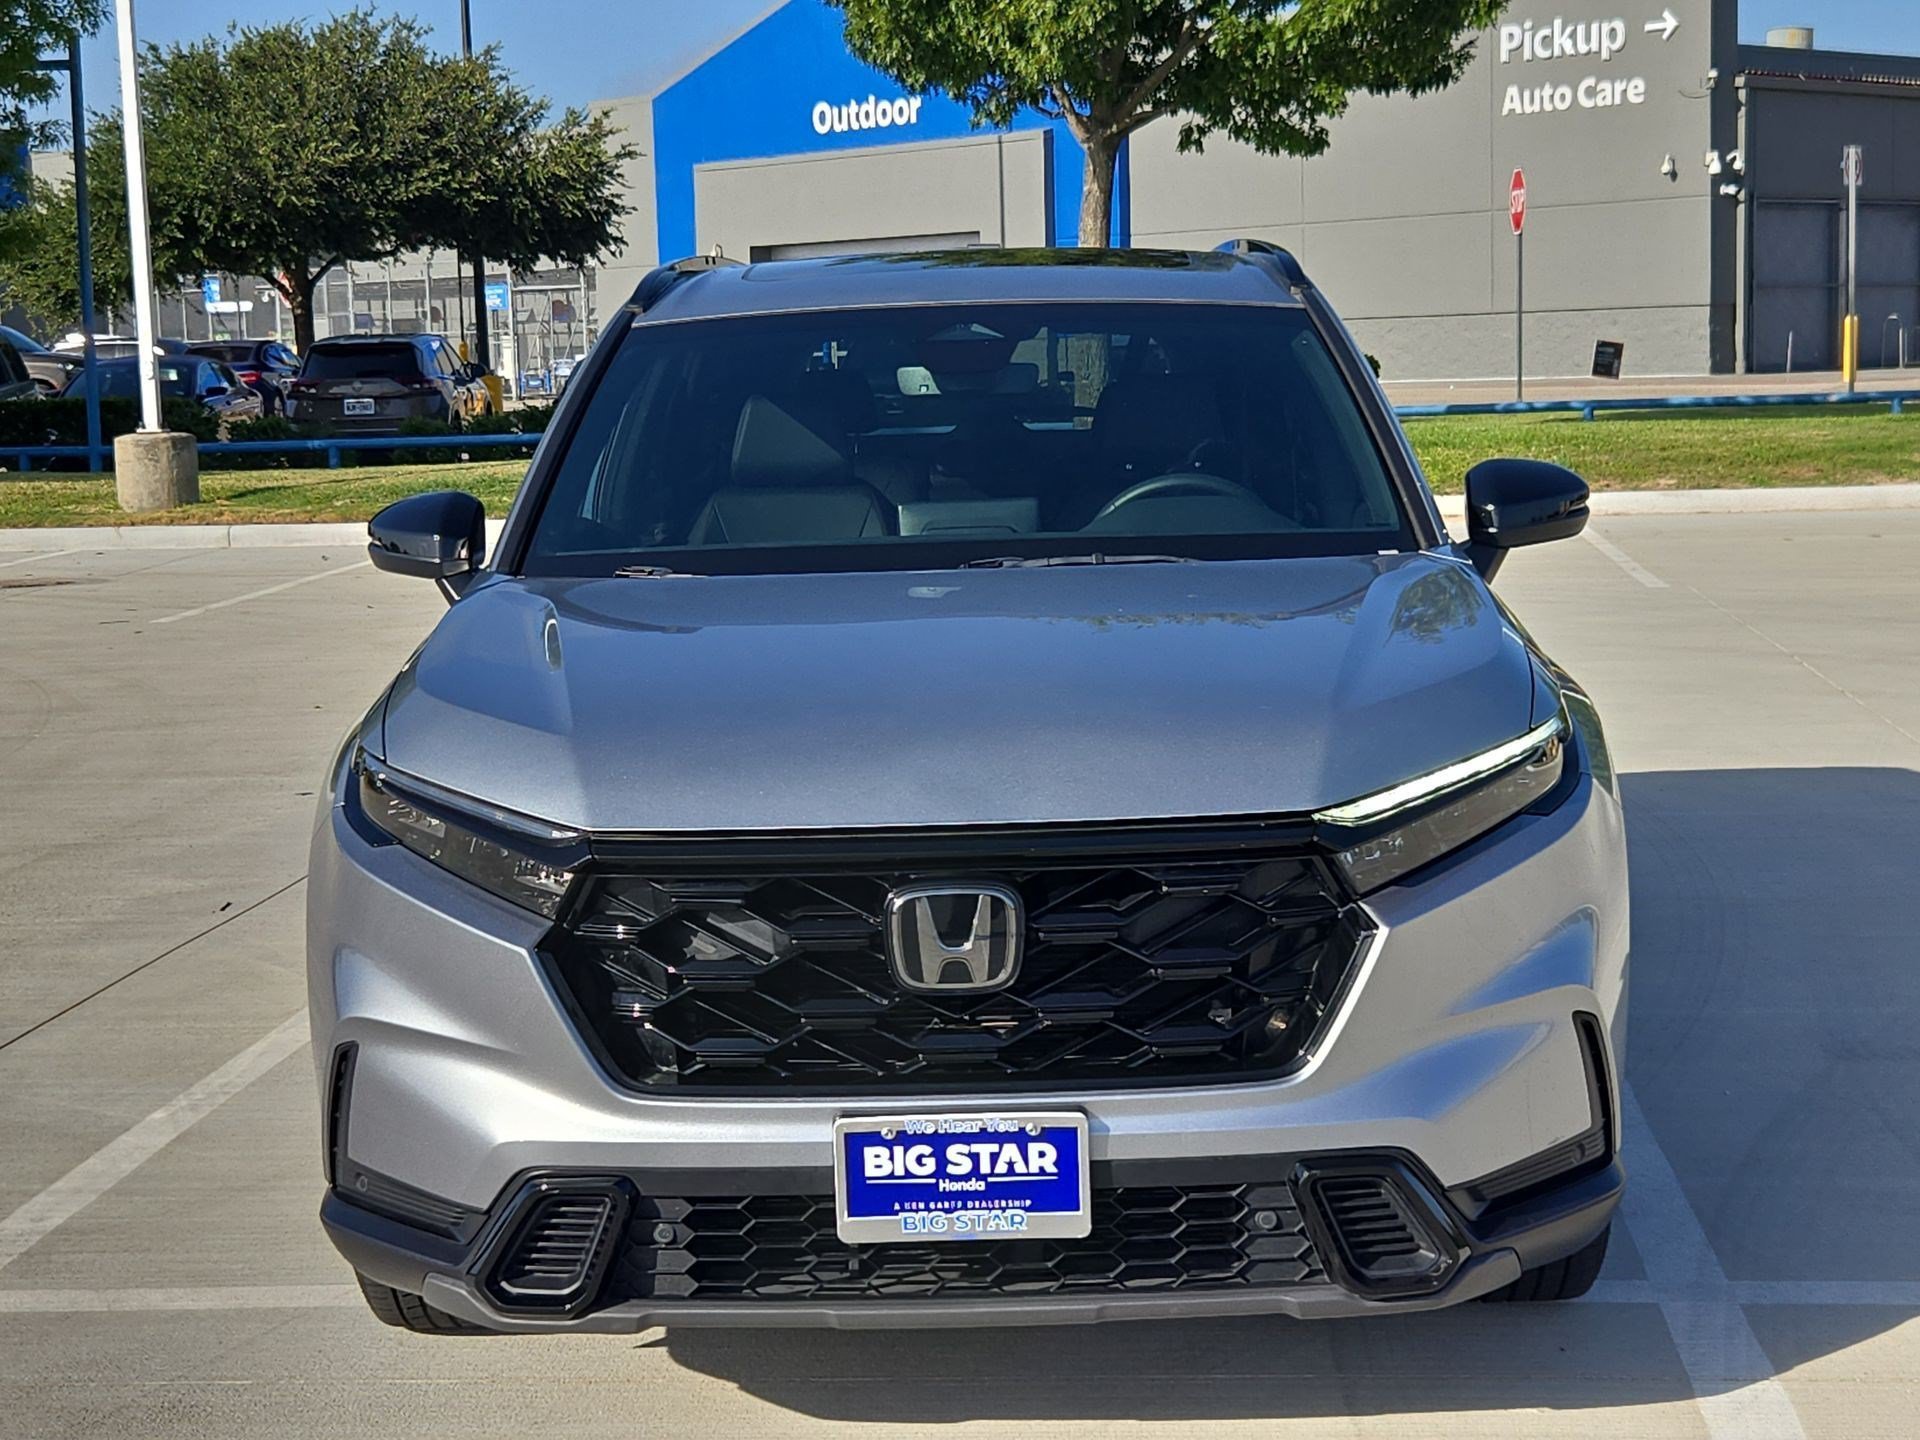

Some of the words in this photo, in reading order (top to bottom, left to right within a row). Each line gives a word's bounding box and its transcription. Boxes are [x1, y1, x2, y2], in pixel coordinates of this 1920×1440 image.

[1500, 17, 1627, 64] Pickup
[1501, 83, 1573, 117] Auto
[1577, 75, 1646, 109] Care
[812, 94, 922, 134] Outdoor
[1511, 189, 1525, 214] STOP
[904, 1119, 935, 1134] We
[938, 1118, 983, 1133] Hear
[984, 1116, 1019, 1132] You
[863, 1144, 937, 1178] BIG
[945, 1142, 1059, 1176] STAR
[939, 1178, 986, 1192] Honda
[966, 1199, 1032, 1209] DEALERSHIP
[900, 1211, 949, 1234] BIG
[952, 1209, 1028, 1232] STAR
